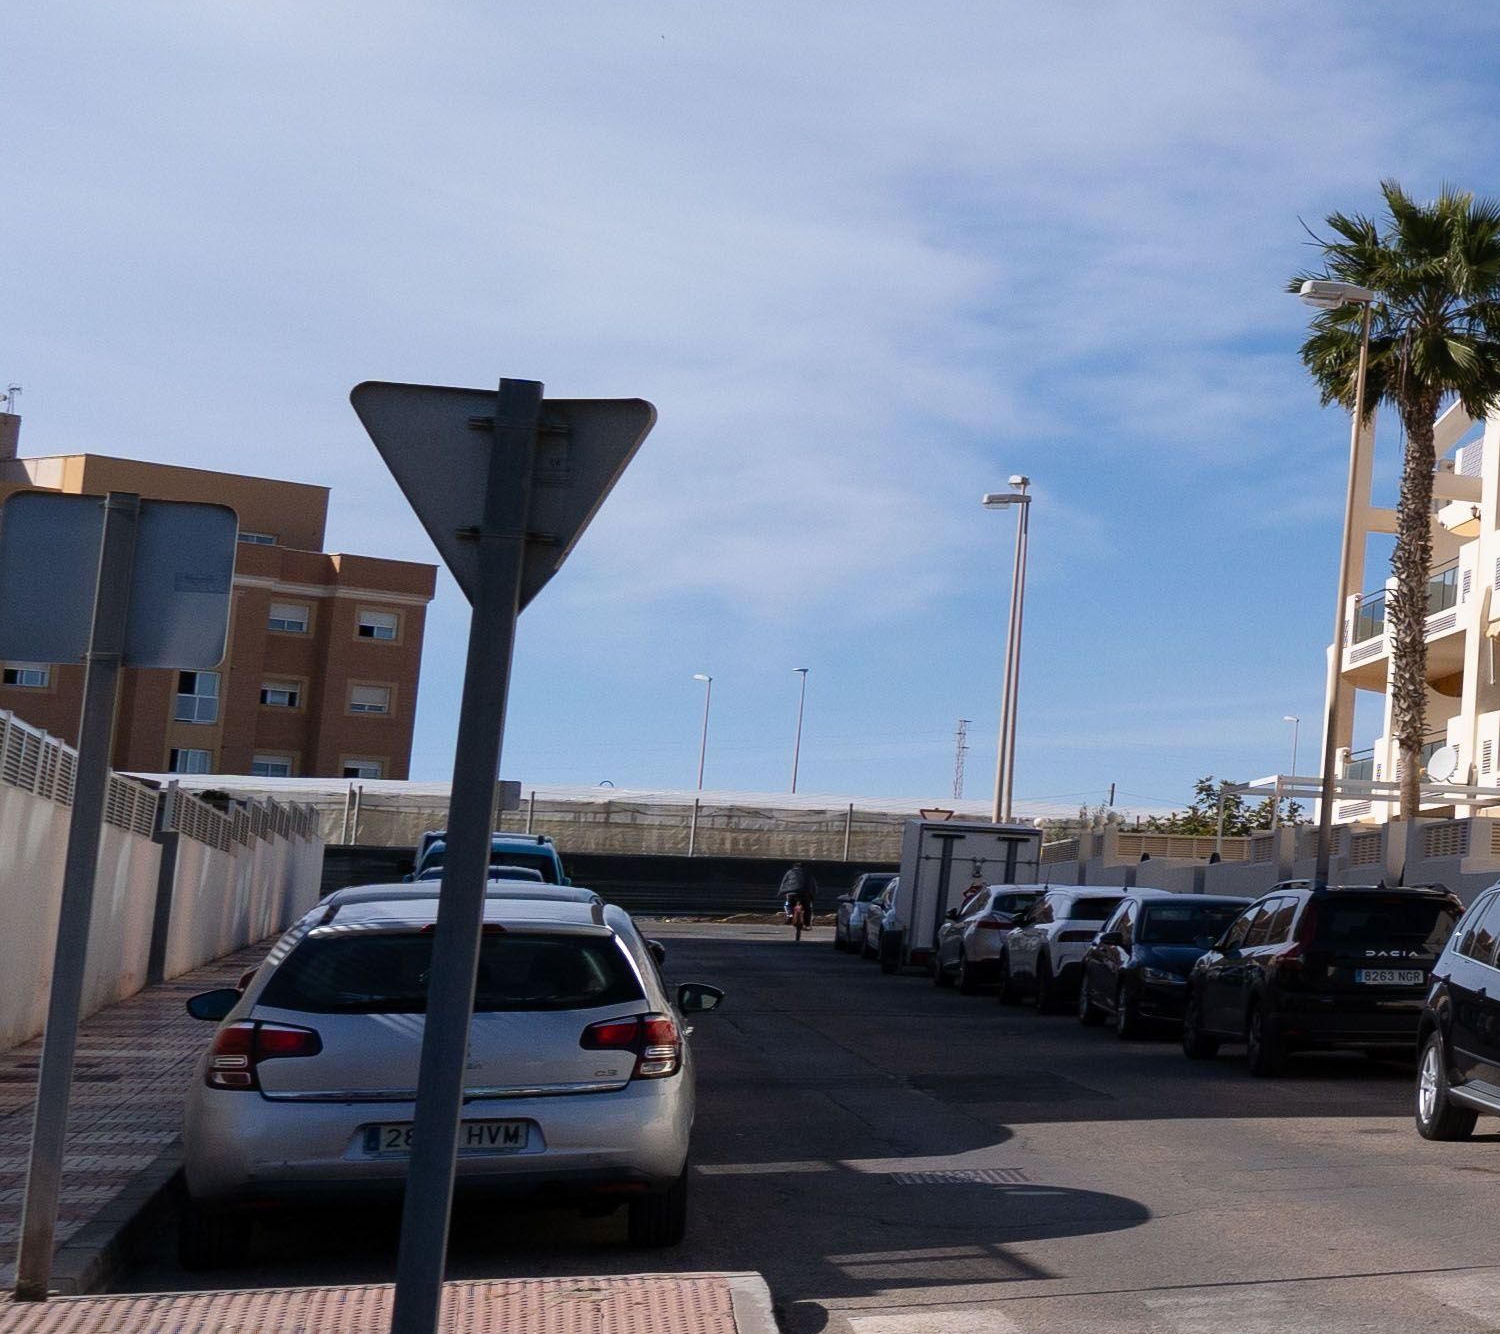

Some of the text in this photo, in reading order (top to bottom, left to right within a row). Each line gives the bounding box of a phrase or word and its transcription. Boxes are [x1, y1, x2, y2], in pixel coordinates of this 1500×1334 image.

[1364, 970, 1395, 982] 8263
[594, 1069, 618, 1078] C3
[466, 1125, 521, 1145] HVM
